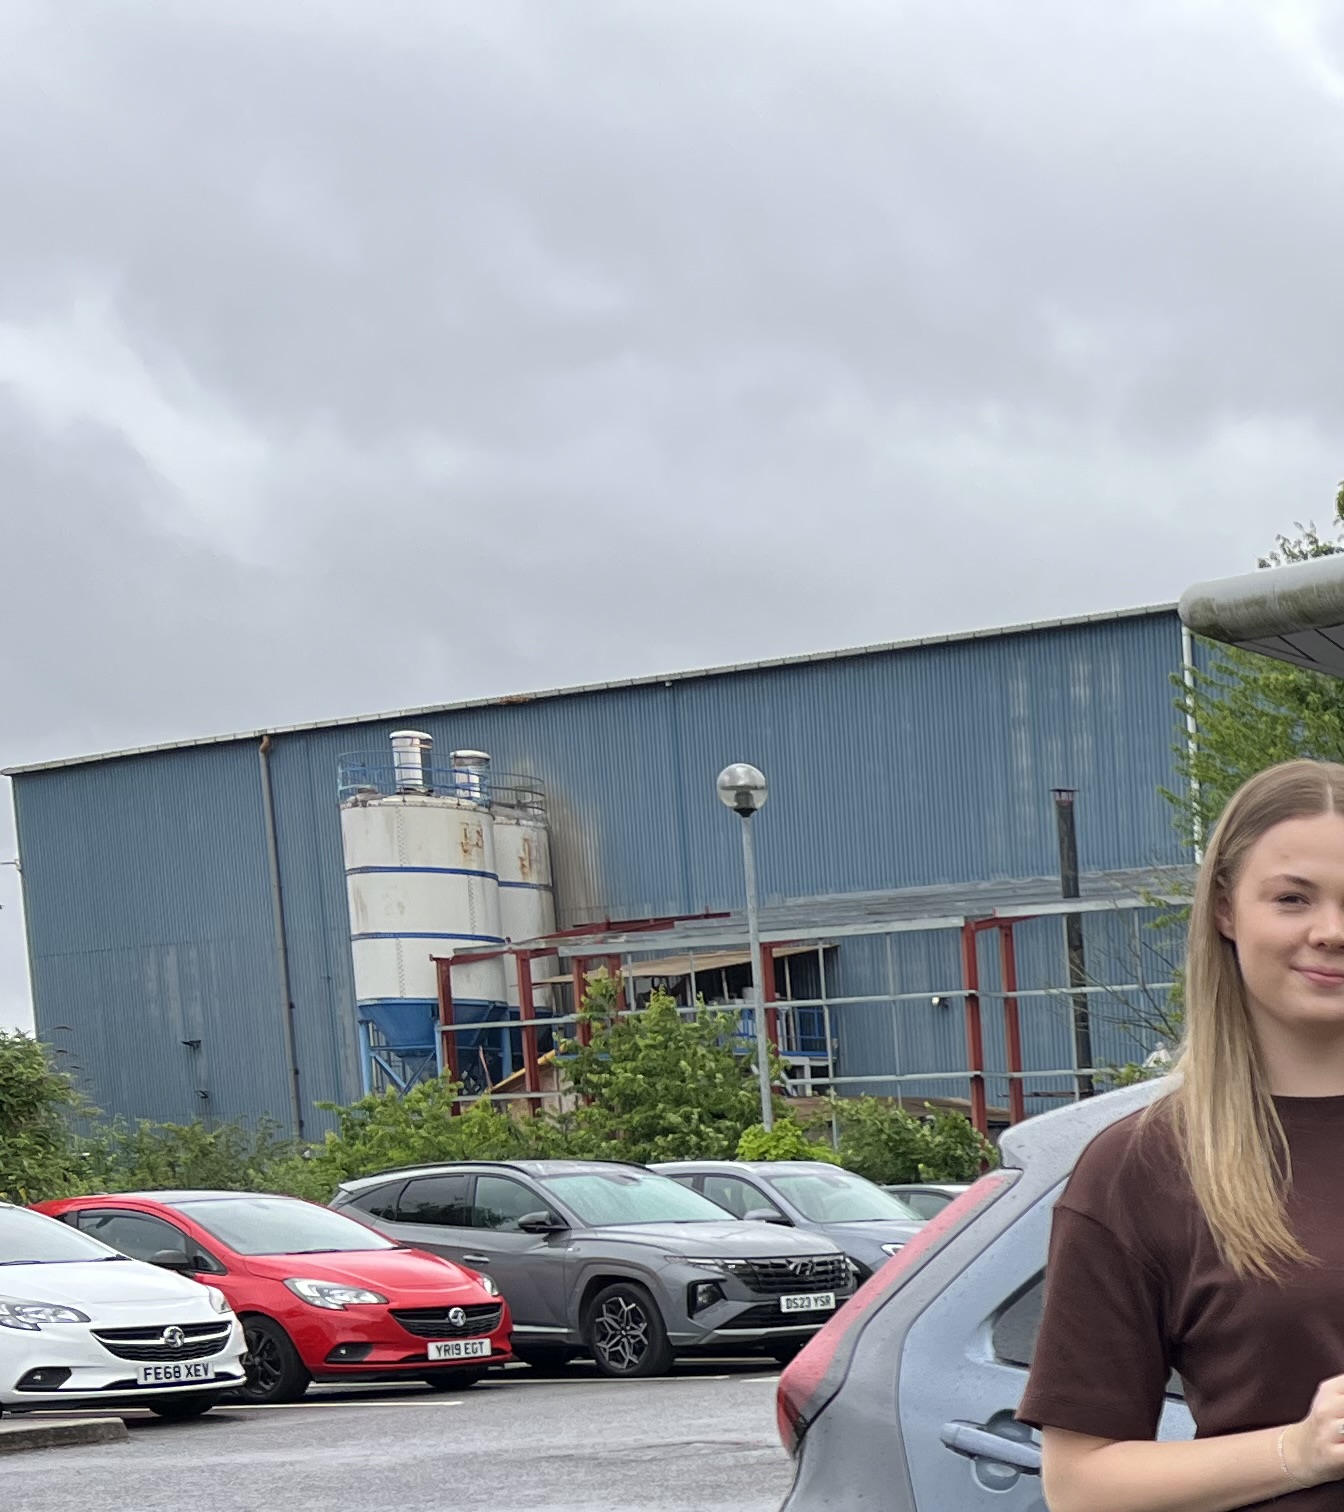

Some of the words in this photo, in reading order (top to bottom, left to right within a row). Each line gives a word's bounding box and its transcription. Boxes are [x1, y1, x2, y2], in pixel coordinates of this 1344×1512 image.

[435, 1343, 462, 1357] YR19
[464, 1341, 484, 1355] EGT
[143, 1365, 182, 1381] FE68
[184, 1362, 209, 1378] XEV
